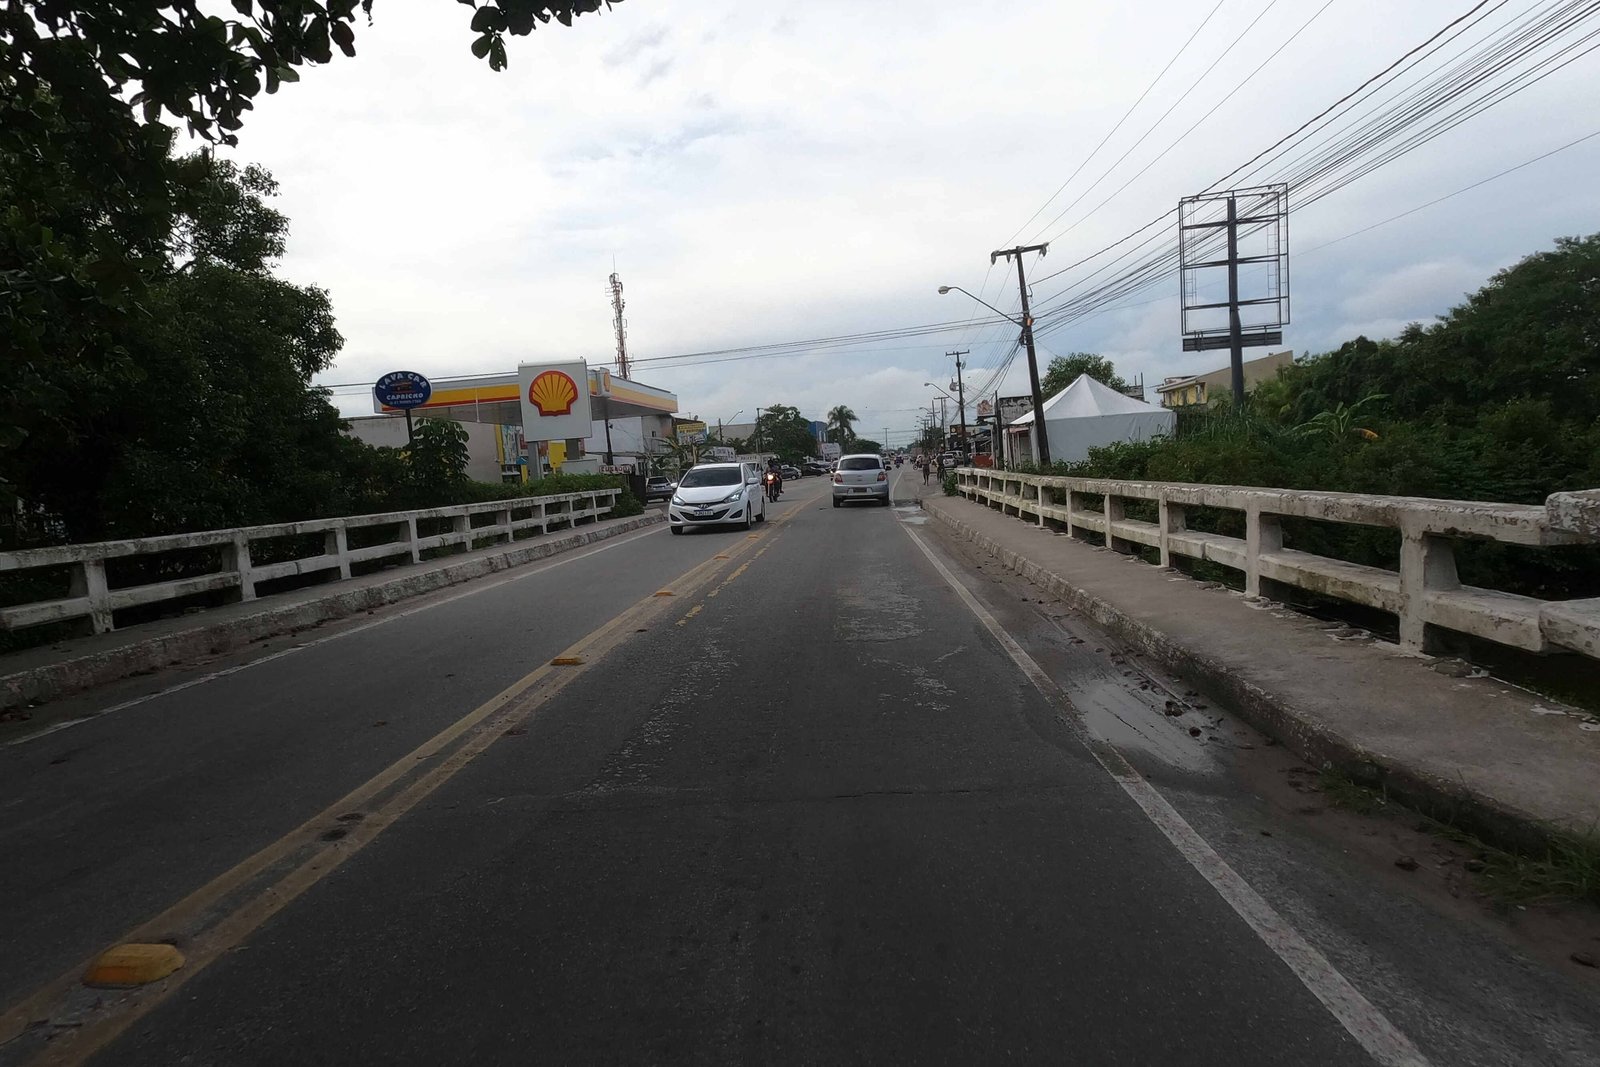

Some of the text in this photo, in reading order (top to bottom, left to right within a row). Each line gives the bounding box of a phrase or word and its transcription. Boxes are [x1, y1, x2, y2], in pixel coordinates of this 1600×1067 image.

[379, 372, 427, 390] LAVA CAR
[386, 392, 424, 401] CAPRICHO
